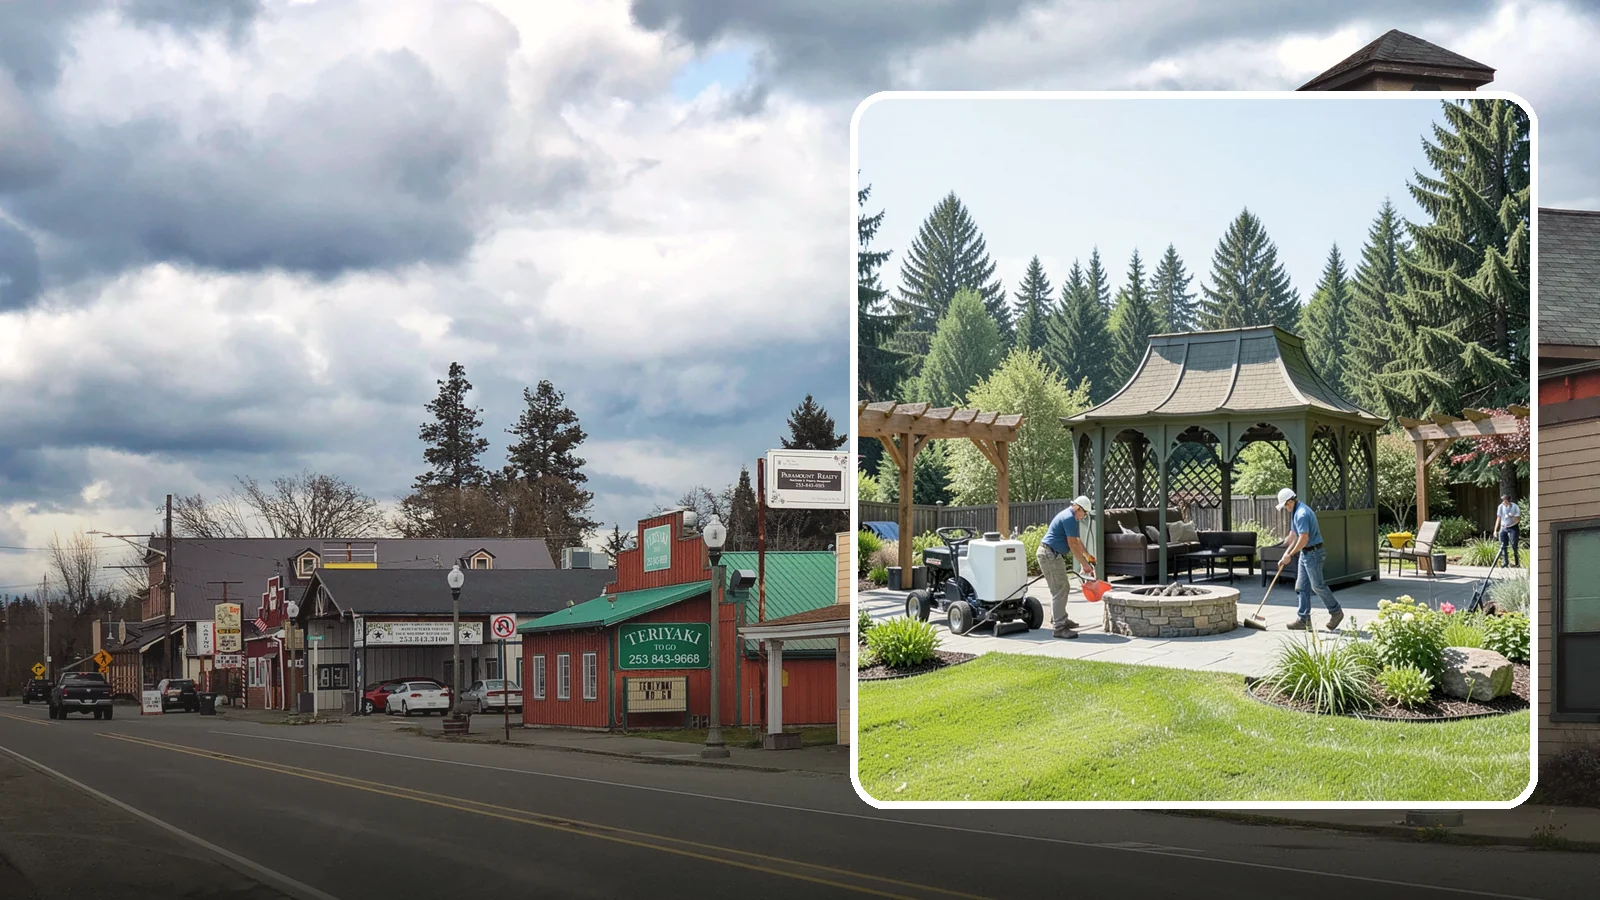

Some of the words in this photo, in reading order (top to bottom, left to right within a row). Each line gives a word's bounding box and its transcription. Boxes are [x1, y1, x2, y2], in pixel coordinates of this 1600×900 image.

[781, 471, 815, 479] PARAMOUNT
[817, 472, 839, 480] REALTY
[624, 627, 703, 646] TERIYAKI
[628, 654, 649, 665] 253
[651, 653, 700, 664] 843-9668
